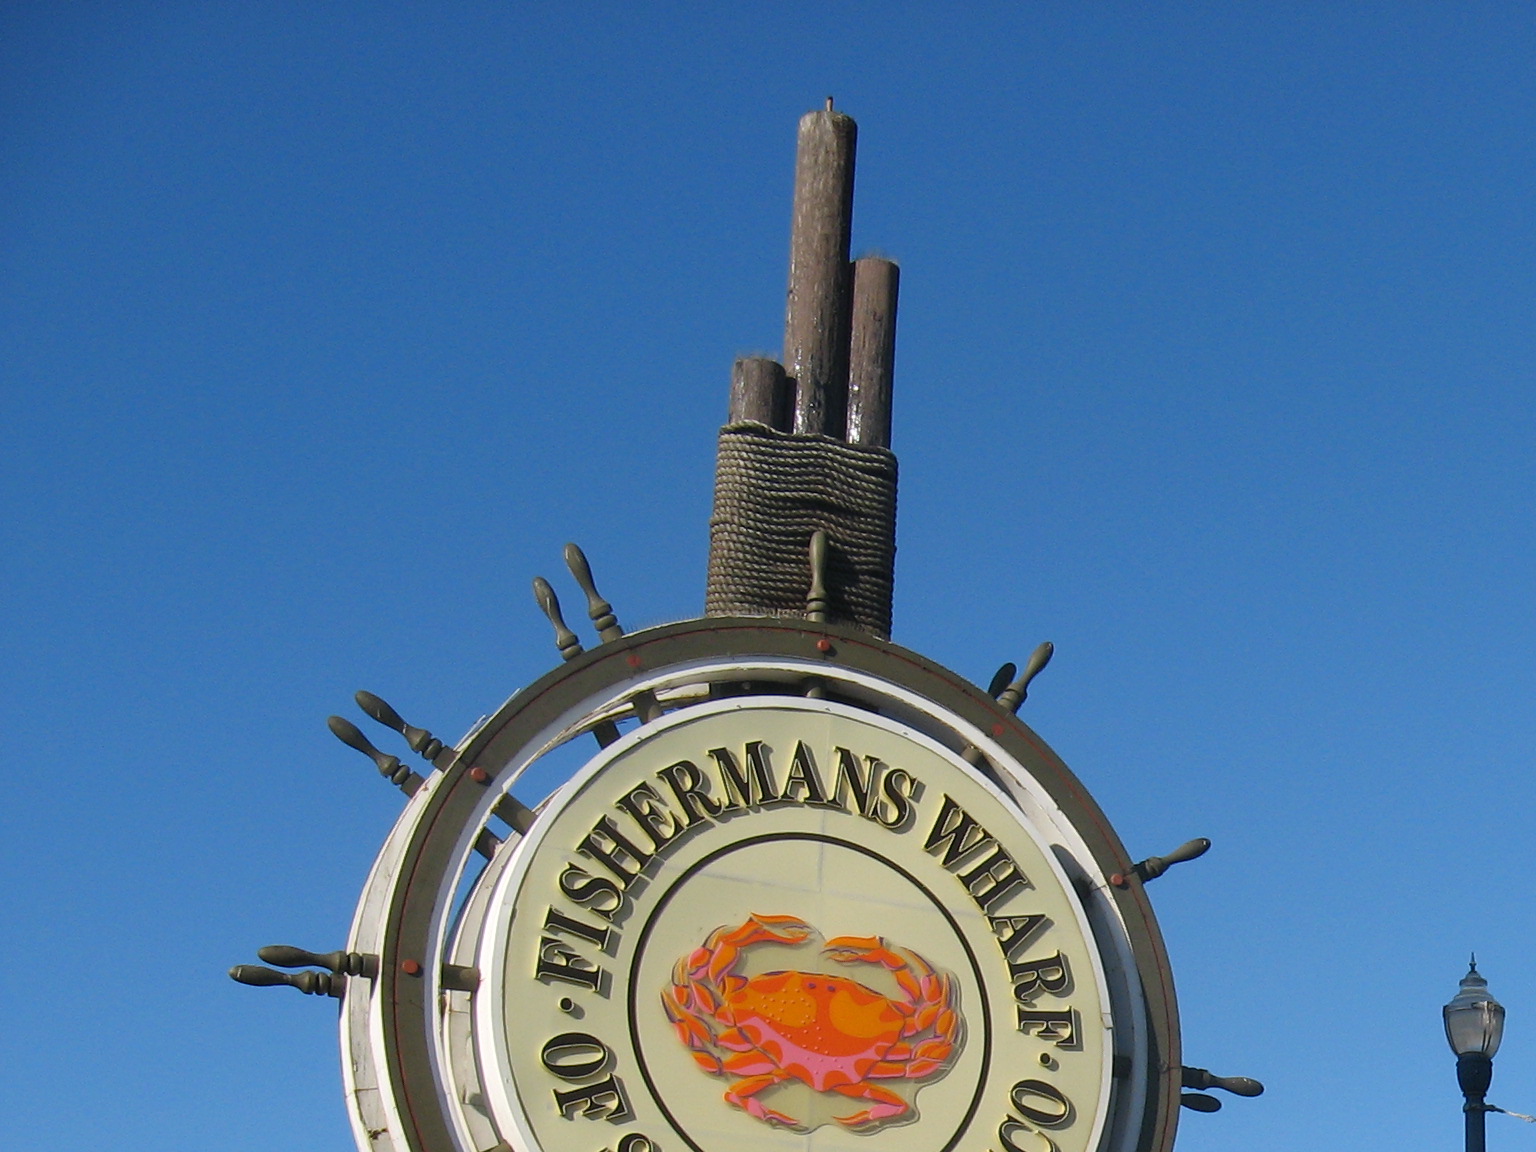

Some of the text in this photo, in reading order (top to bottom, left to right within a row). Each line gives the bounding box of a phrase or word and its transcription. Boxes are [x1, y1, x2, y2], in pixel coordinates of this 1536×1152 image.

[535, 739, 1083, 1051] FISHERMANS WHARF
[540, 1031, 635, 1124] OF
